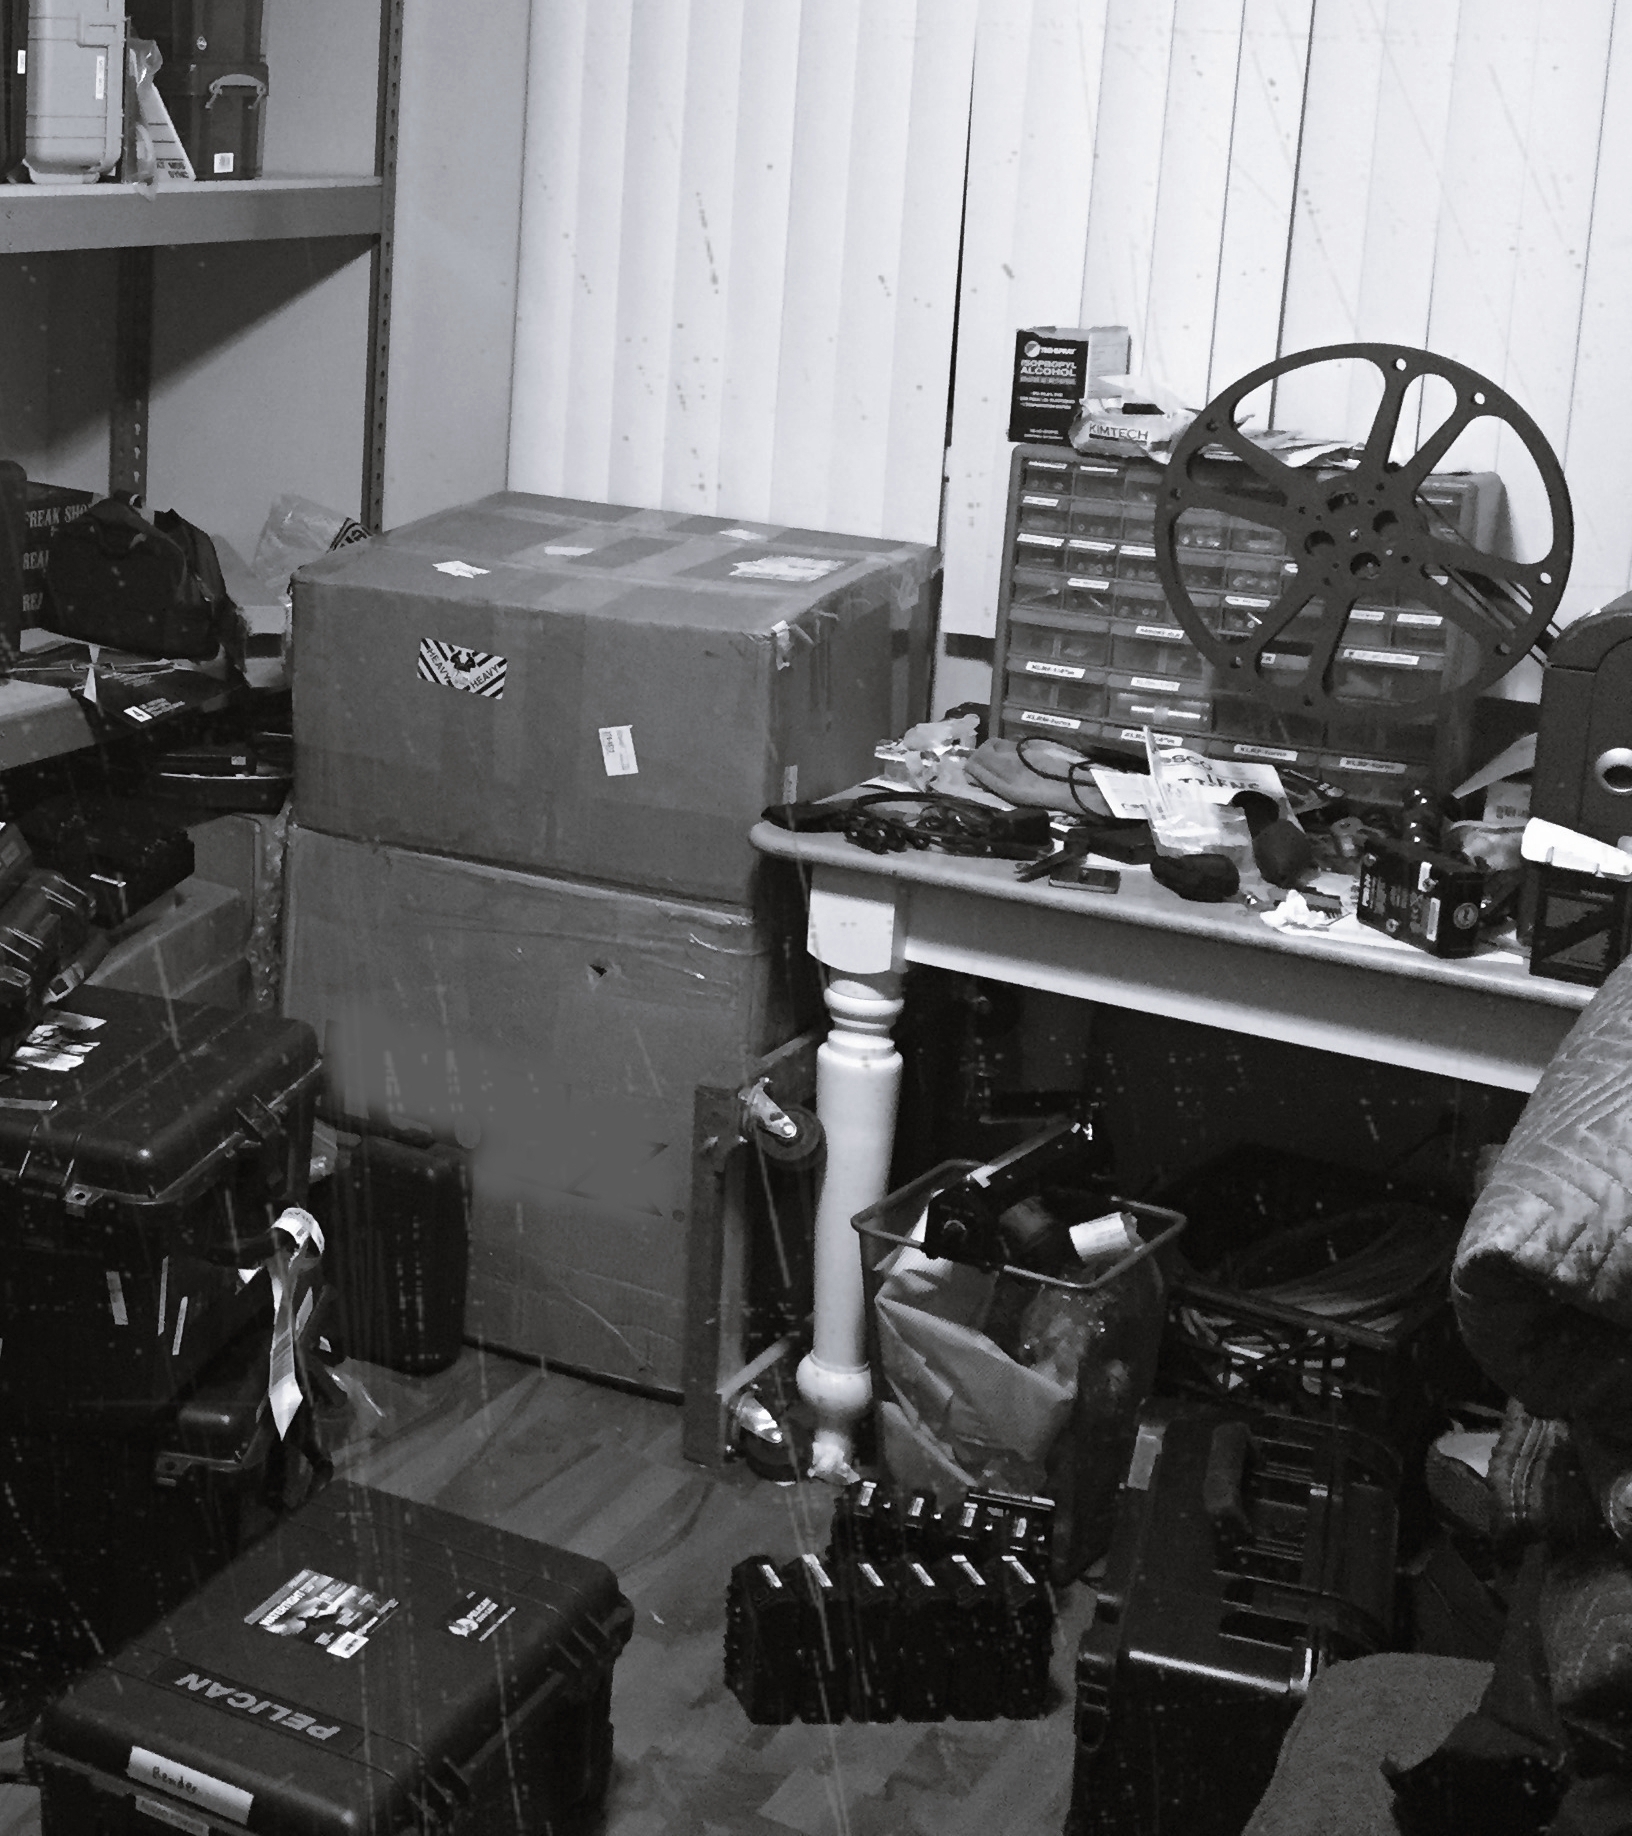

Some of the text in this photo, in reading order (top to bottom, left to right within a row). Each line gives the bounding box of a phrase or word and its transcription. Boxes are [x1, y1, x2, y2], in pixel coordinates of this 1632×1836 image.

[1020, 359, 1077, 369] ISOPROPYL
[1020, 367, 1077, 377] ALCOHOL
[1088, 423, 1150, 440] KIMTECH
[64, 503, 88, 523] SHO
[427, 647, 451, 680] HEAVY
[470, 664, 499, 689] HEAVY
[174, 1672, 341, 1741] PELICAN
